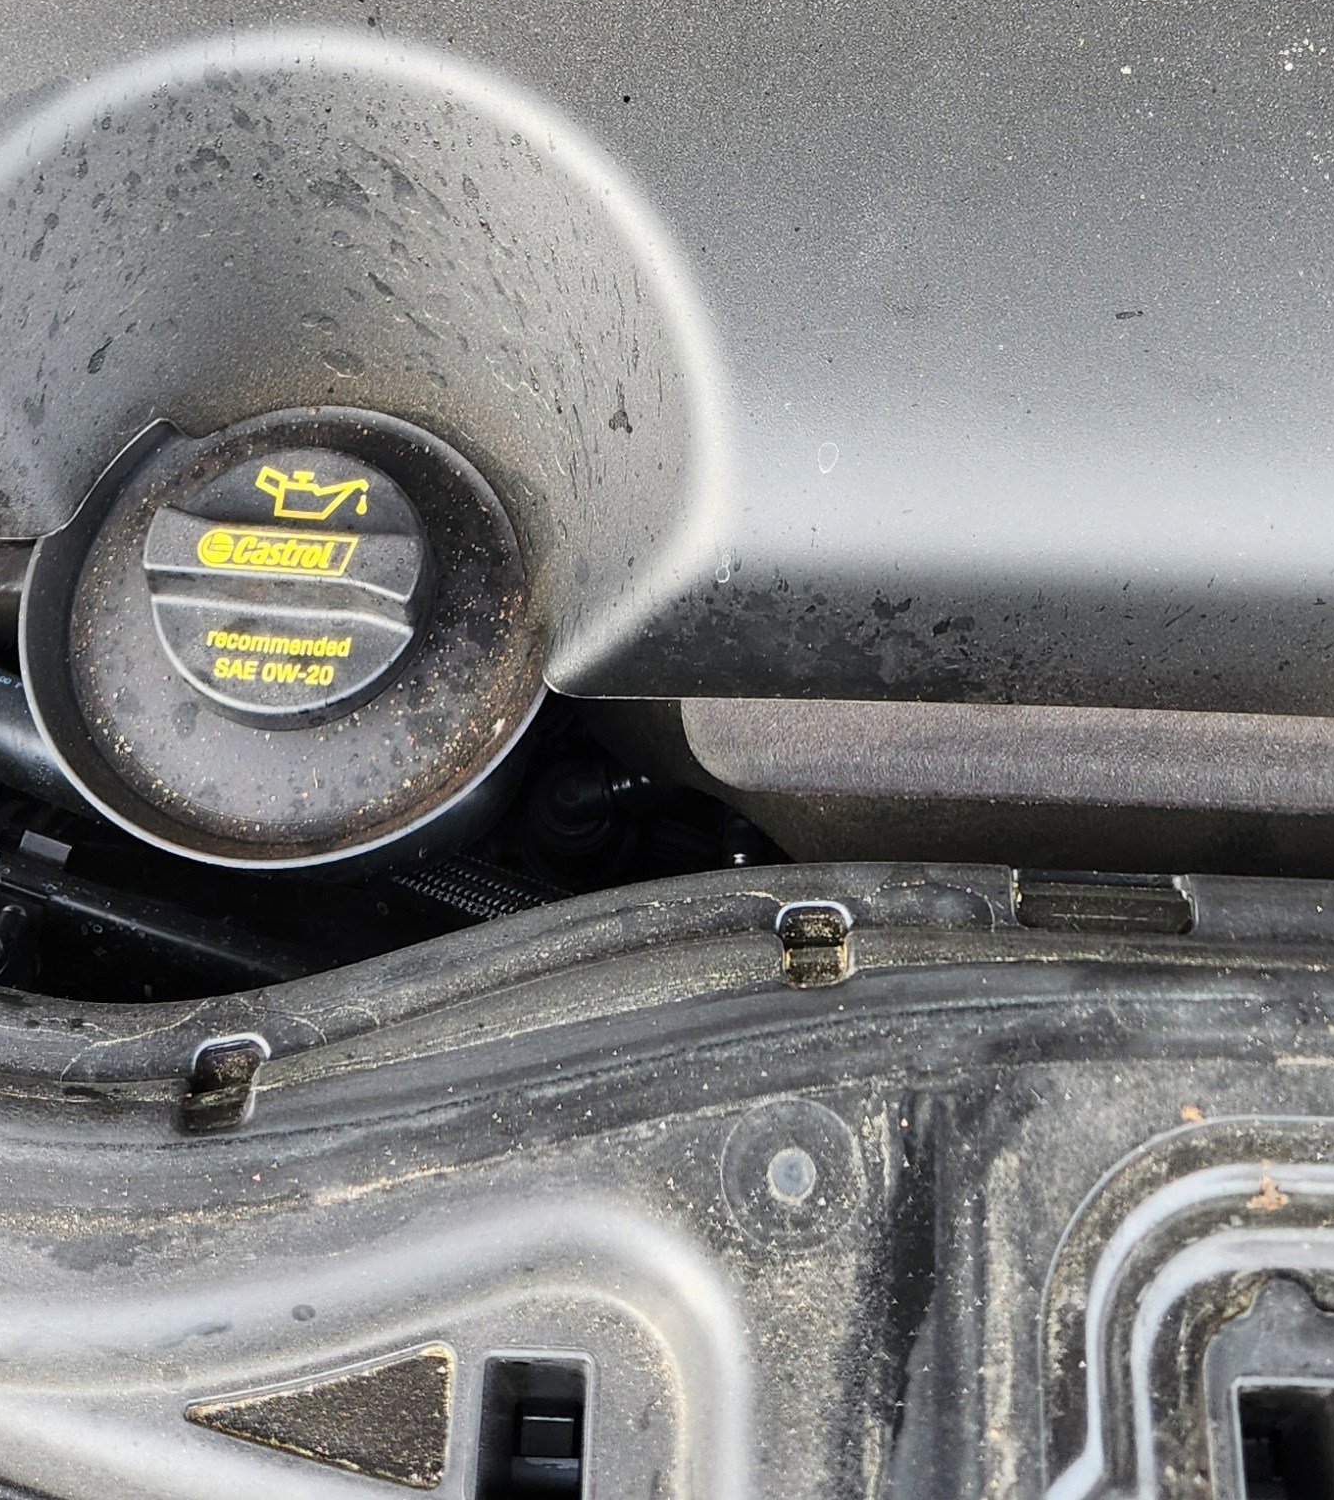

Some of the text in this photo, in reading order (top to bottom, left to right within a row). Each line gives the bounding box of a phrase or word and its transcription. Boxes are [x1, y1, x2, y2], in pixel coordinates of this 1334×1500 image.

[231, 535, 331, 569] Castrol
[206, 629, 351, 658] recommended
[213, 657, 335, 687] SAE 0W-20
